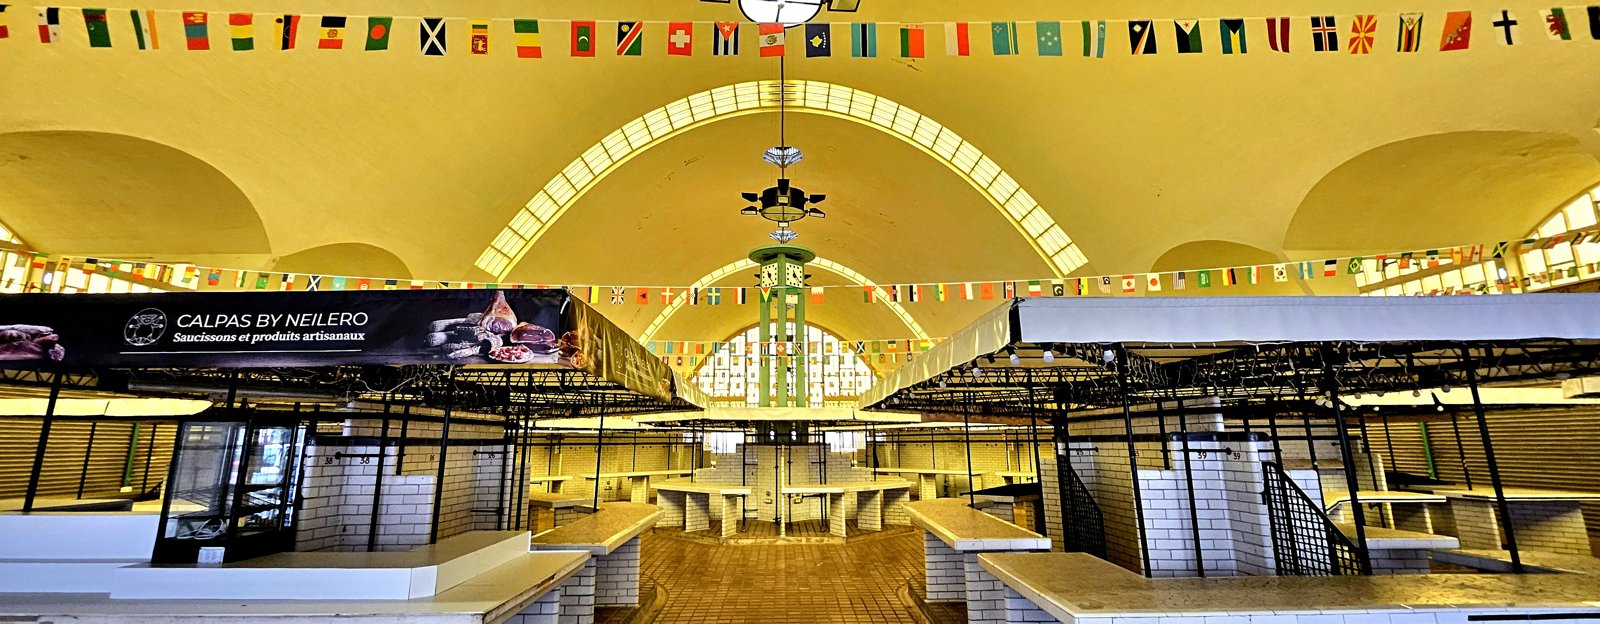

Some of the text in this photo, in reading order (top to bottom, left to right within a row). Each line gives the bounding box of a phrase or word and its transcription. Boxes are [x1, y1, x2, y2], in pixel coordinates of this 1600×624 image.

[176, 312, 368, 328] CALPAS BY NEILERO
[173, 330, 365, 344] Saucissons et produits artisanaux
[360, 456, 370, 464] 38
[1197, 450, 1208, 460] 39
[1232, 452, 1240, 460] 39
